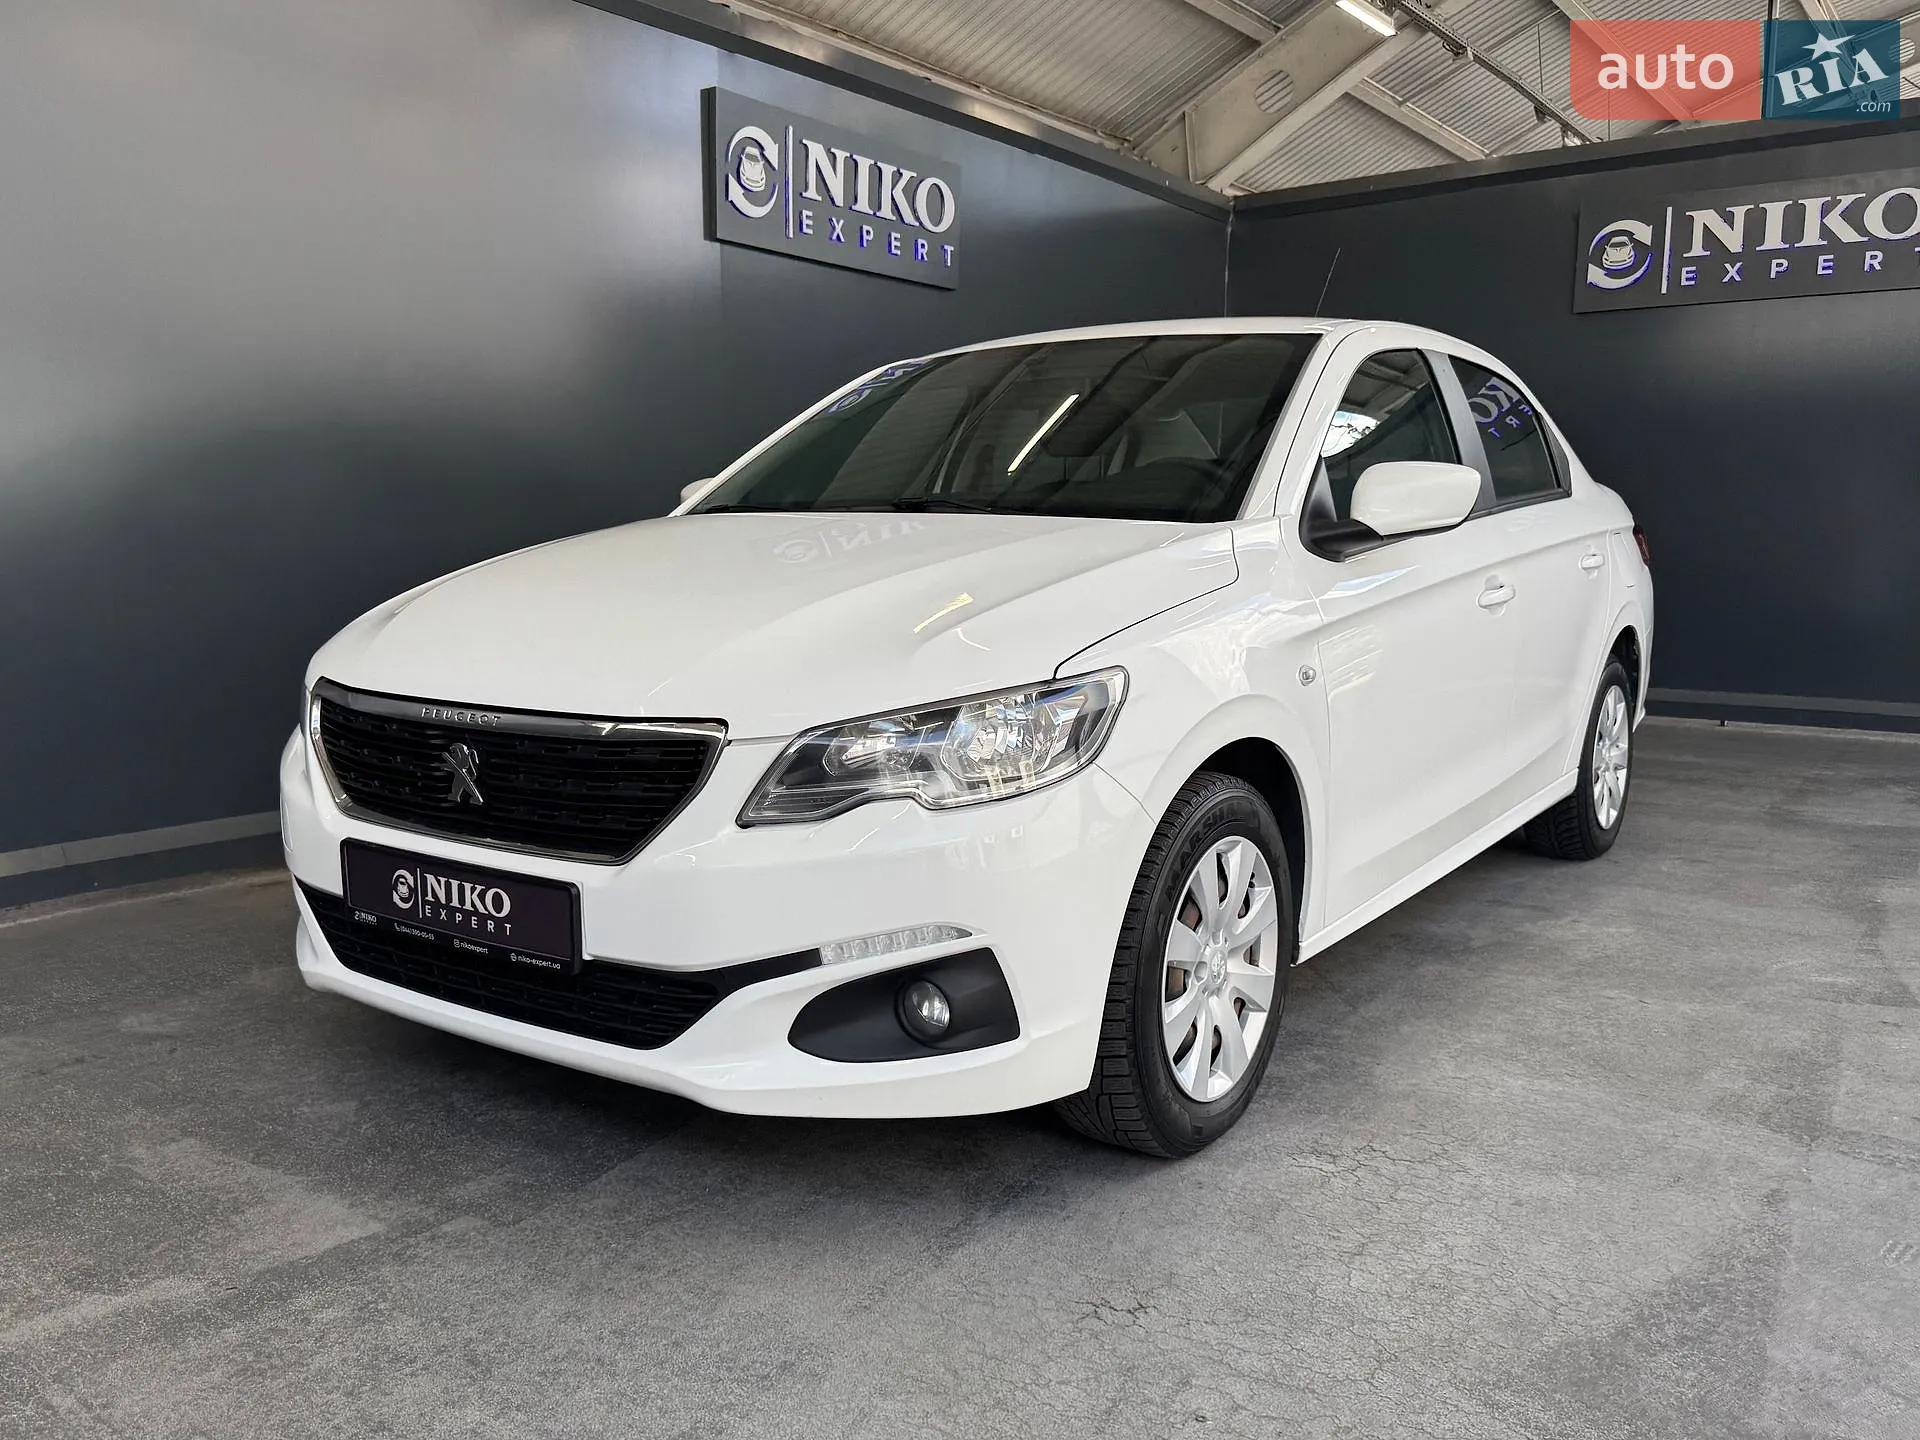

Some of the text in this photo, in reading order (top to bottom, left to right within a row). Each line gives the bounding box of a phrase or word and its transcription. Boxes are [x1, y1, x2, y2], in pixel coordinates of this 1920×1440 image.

[801, 138, 956, 234] NIKO
[800, 209, 955, 268] EXPERT
[1683, 187, 1920, 258] NIKO
[421, 707, 501, 726] PEUGEOT
[423, 872, 512, 918] NIKO
[425, 905, 512, 936] EXPERT
[460, 942, 488, 954] nikoexpert
[517, 955, 560, 969] niko-expert.ua
